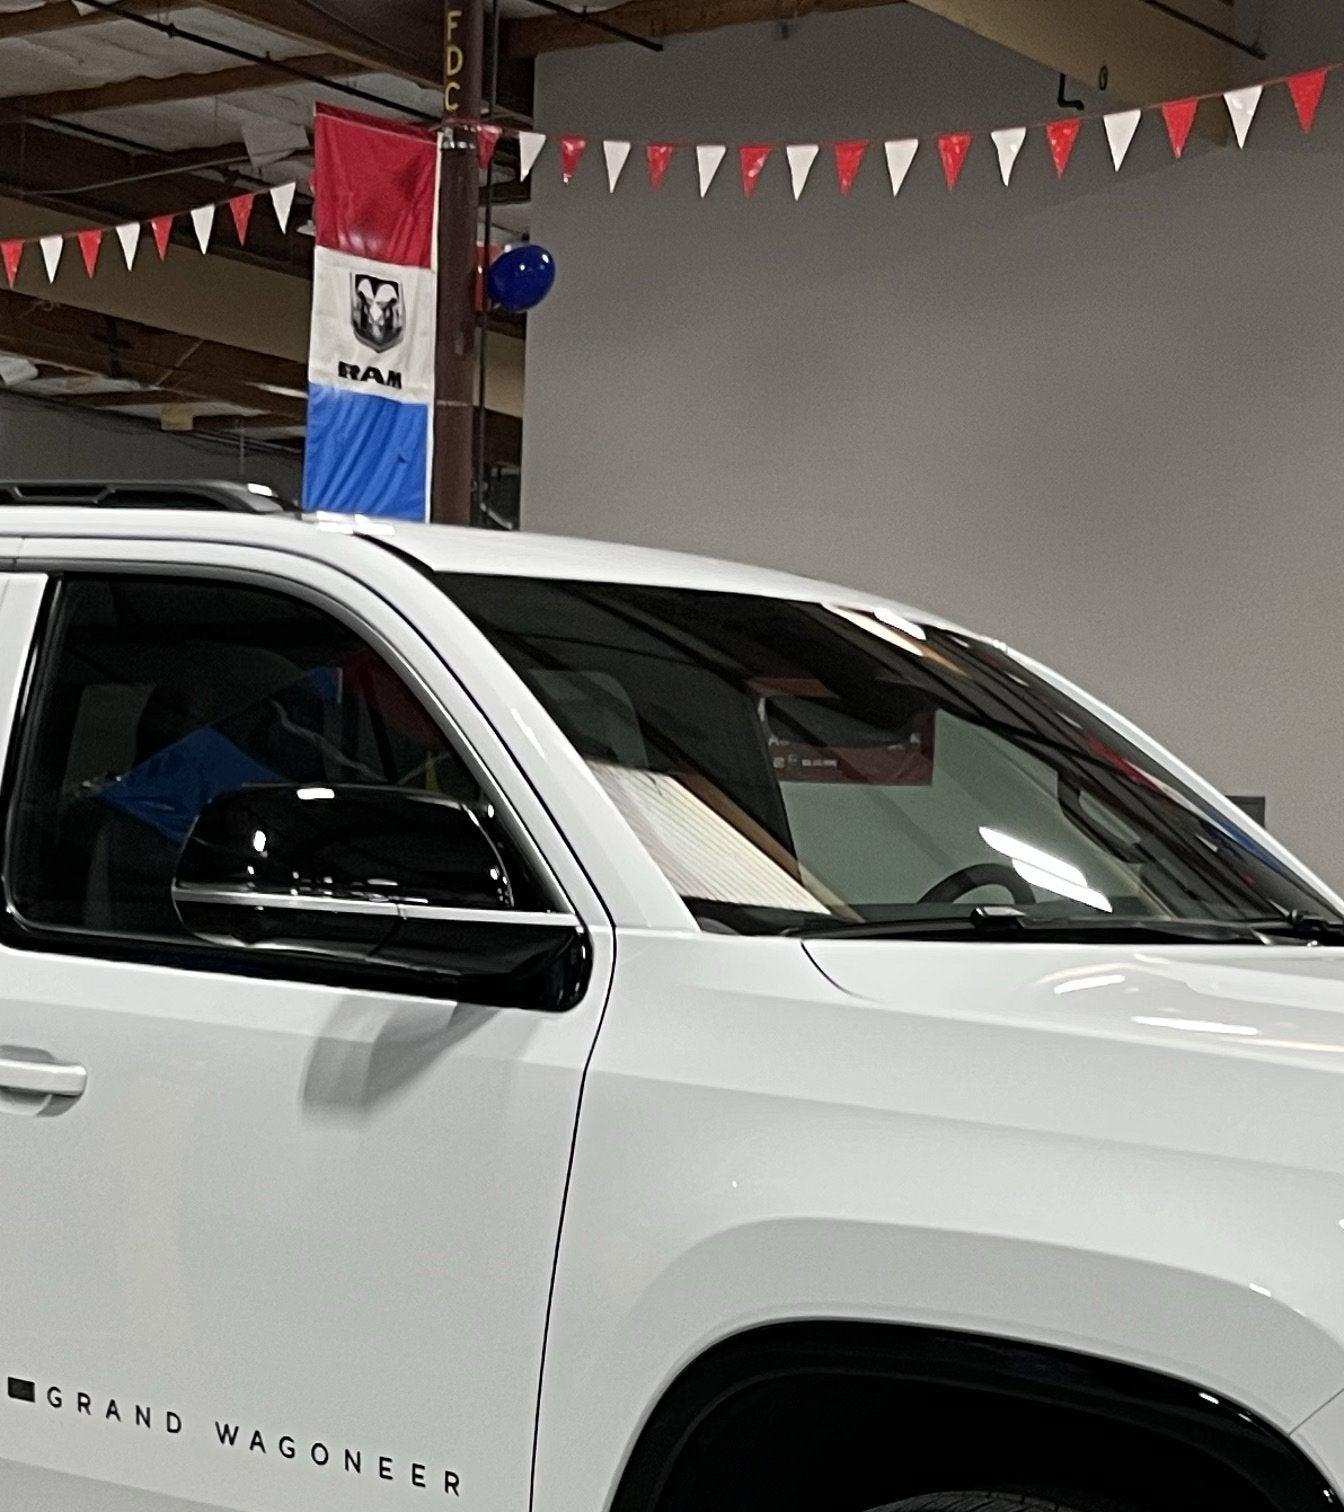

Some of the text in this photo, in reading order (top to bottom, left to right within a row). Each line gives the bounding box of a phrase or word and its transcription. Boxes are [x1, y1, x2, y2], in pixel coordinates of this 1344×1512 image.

[445, 10, 464, 111] FDC
[337, 360, 402, 390] RAM
[46, 1385, 460, 1497] GRAND WAGONEER
